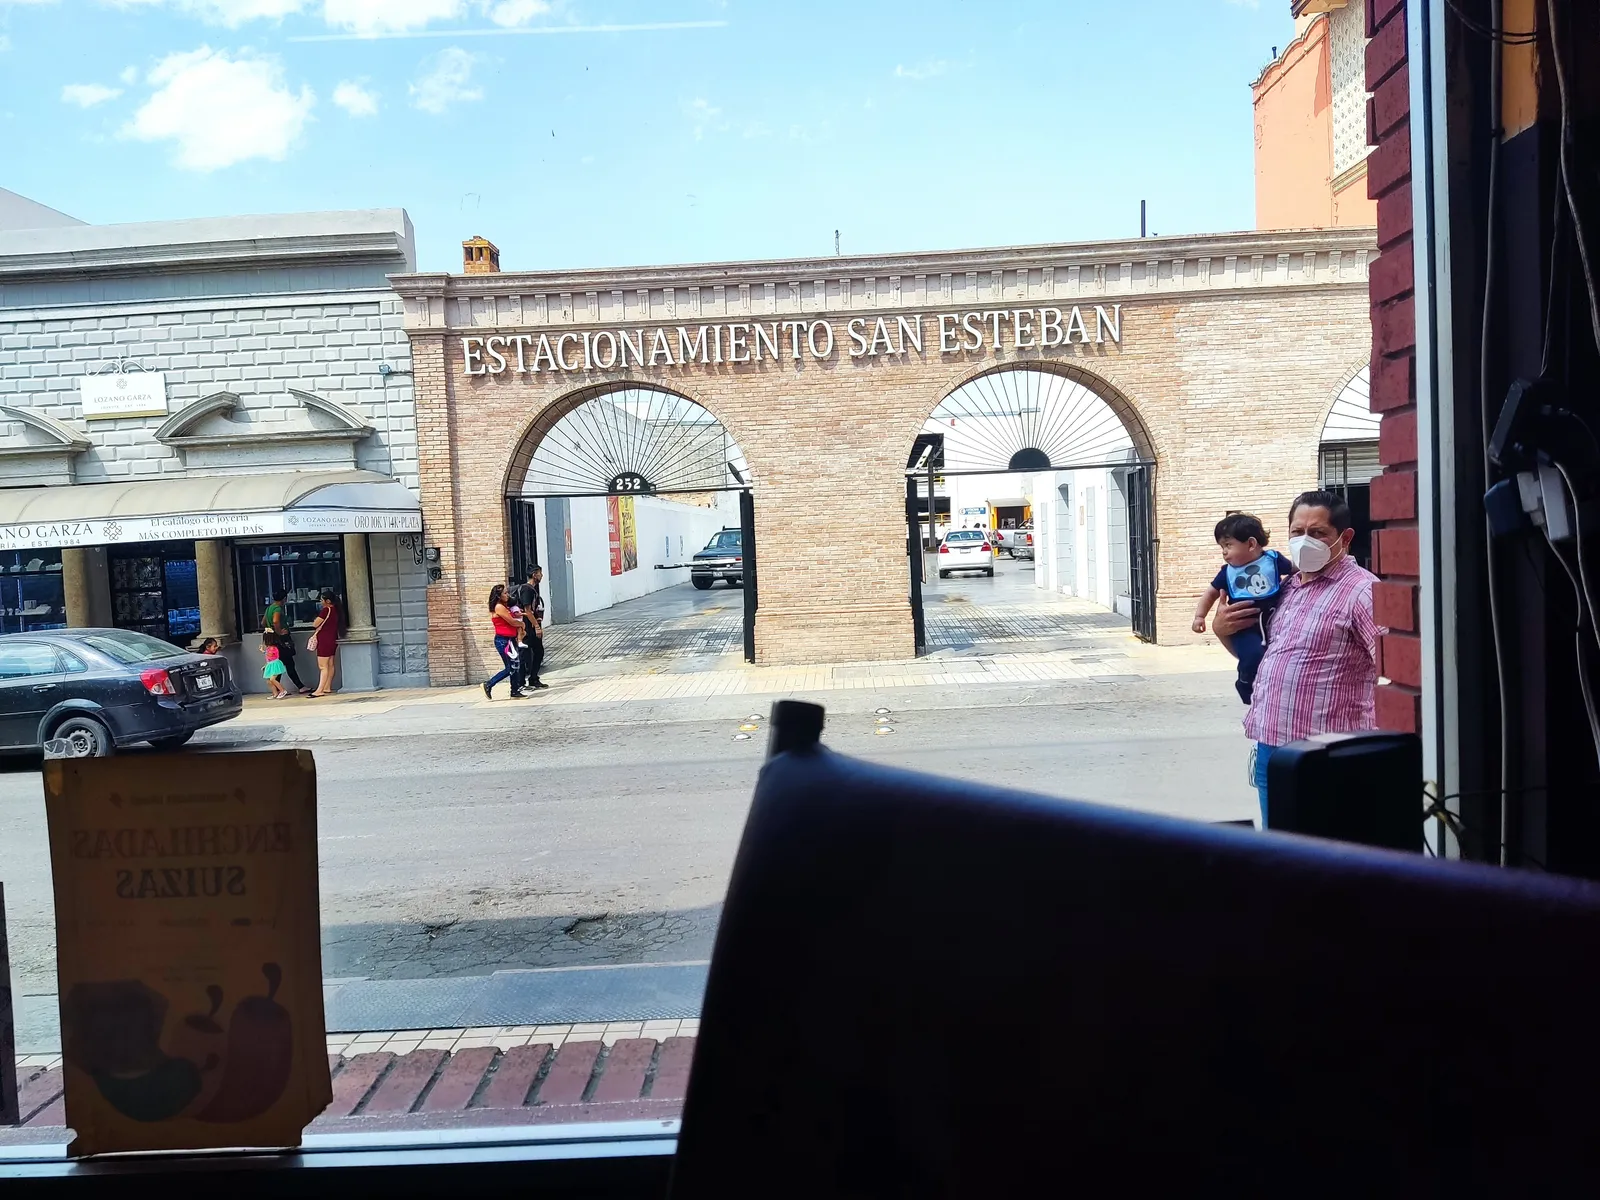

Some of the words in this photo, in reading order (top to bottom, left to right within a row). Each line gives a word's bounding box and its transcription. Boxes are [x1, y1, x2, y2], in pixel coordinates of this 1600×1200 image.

[462, 318, 835, 378] ESTACIONAMIENTO
[847, 313, 923, 358] SAN
[937, 303, 1123, 354] ESTEBAN
[93, 395, 125, 403] LOZANO
[126, 394, 152, 402] GARZA
[616, 478, 641, 490] 252
[150, 517, 160, 527] El
[162, 516, 201, 527] catálogo
[203, 515, 215, 524] de
[216, 514, 249, 525] joyería
[354, 515, 370, 529] ORO
[36, 523, 93, 538] GARZA
[138, 529, 160, 541] MÁS
[161, 528, 218, 539] COMPLETO
[220, 527, 239, 536] DEL
[242, 525, 264, 534] PAÍS
[58, 538, 81, 546] 1984
